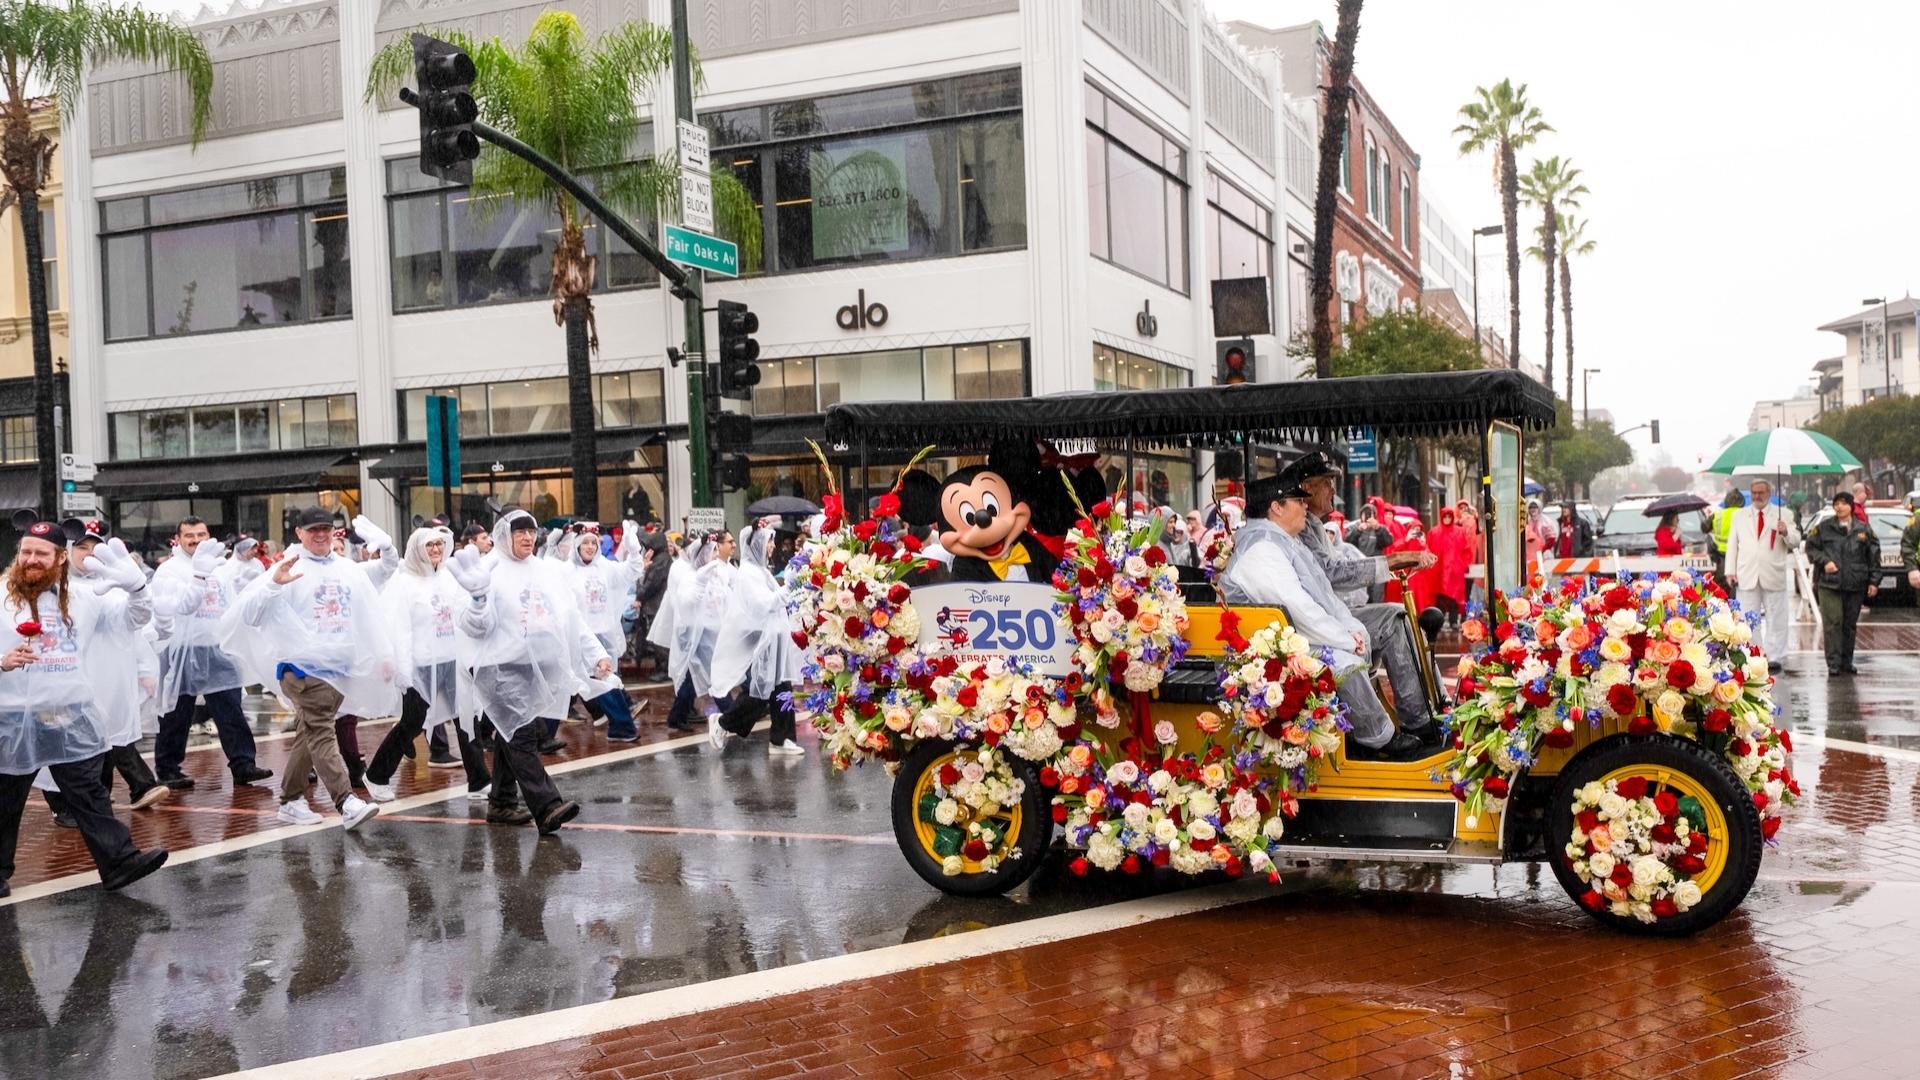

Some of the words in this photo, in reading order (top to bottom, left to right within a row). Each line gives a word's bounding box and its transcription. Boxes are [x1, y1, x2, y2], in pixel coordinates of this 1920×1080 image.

[681, 127, 707, 143] TRUCK
[682, 141, 708, 158] ROUTE
[684, 177, 694, 191] DO
[697, 180, 709, 197] NOT
[686, 197, 710, 215] BLOCK
[686, 214, 712, 228] INTERSECTION
[668, 235, 690, 254] Fair
[693, 245, 719, 262] Oaks
[722, 255, 735, 266] Av
[836, 288, 889, 330] alo
[1136, 299, 1158, 338] alo
[968, 609, 1056, 650] 250
[942, 654, 1006, 664] LEBRATS
